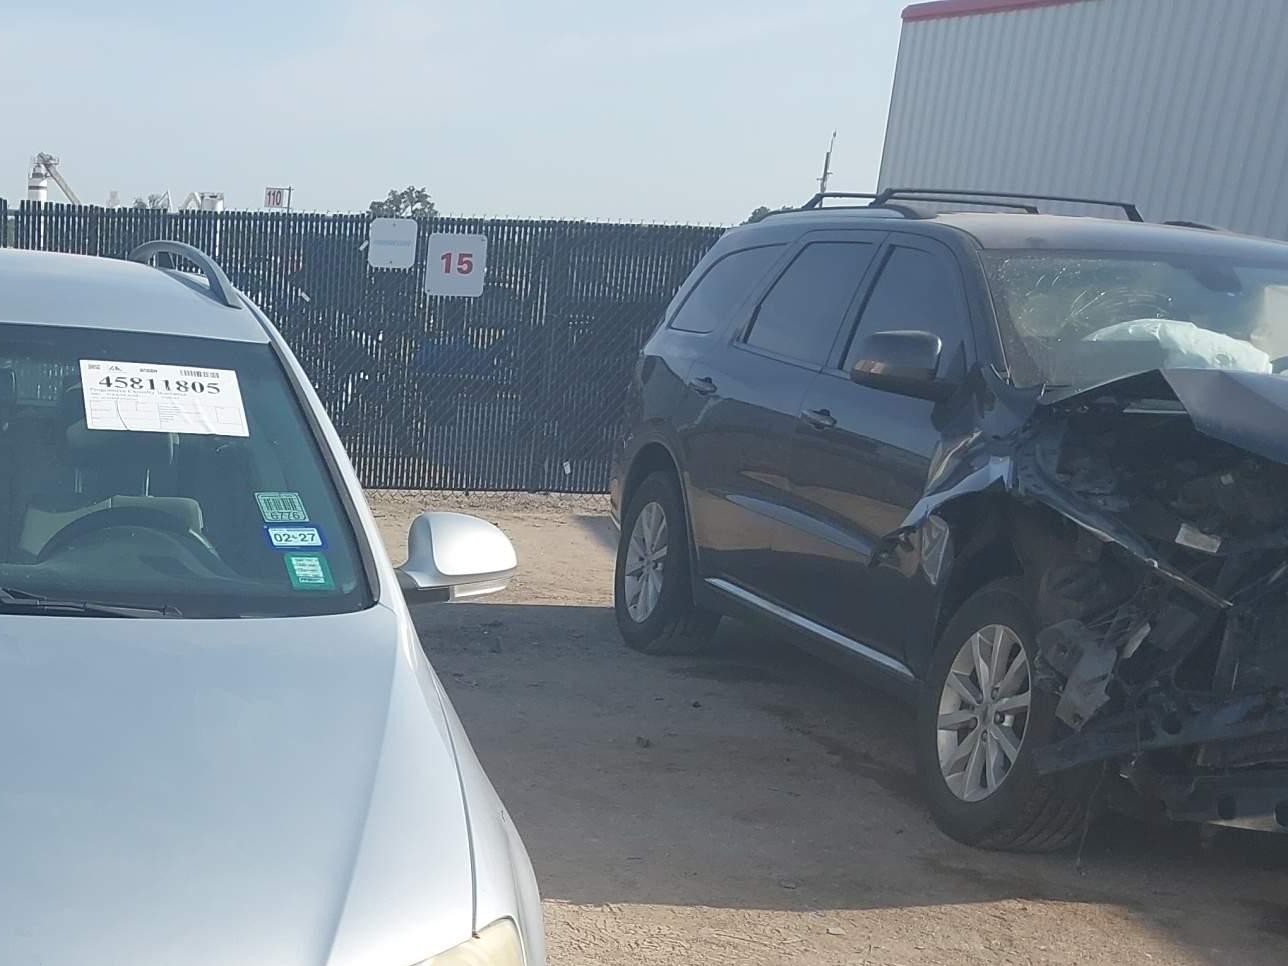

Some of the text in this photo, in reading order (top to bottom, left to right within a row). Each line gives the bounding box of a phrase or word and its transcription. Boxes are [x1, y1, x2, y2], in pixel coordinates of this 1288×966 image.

[267, 190, 282, 206] 110
[441, 252, 474, 275] 15
[99, 375, 221, 395] 45811805
